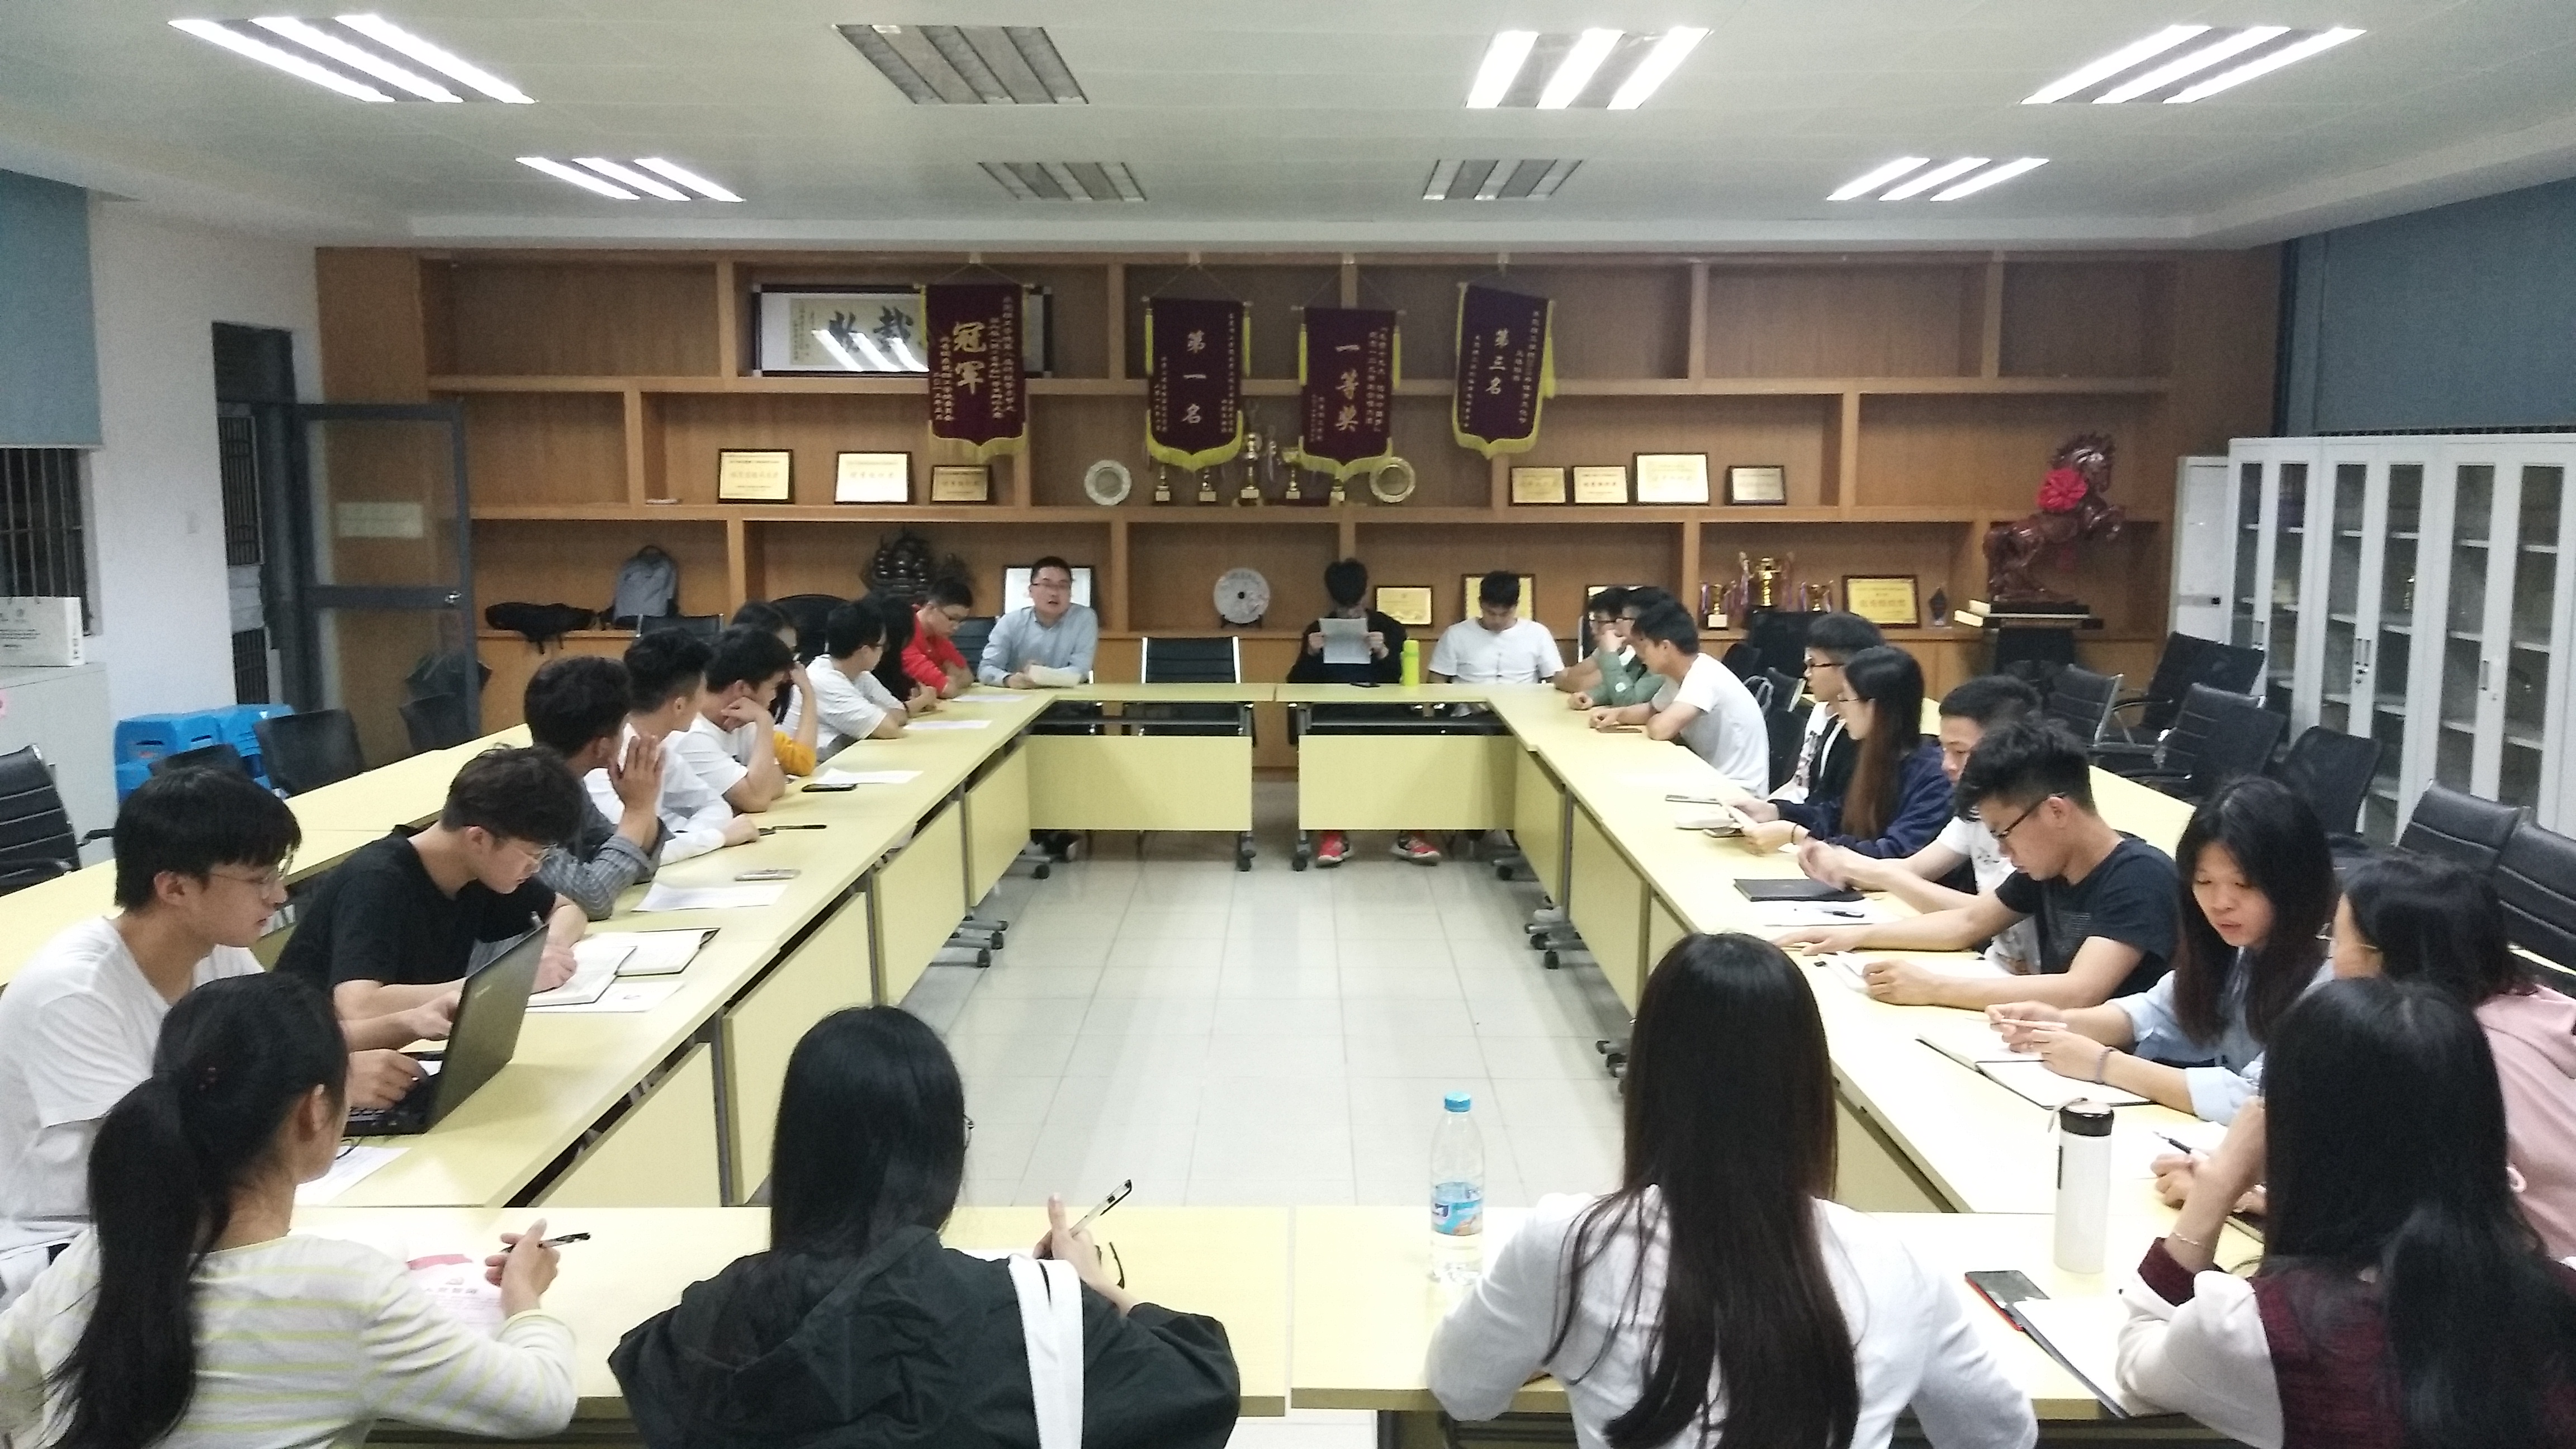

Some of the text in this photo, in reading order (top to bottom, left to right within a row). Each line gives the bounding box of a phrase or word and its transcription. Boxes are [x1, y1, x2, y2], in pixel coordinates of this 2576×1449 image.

[1182, 330, 1206, 424] 第一名
[1485, 329, 1509, 395] 第三名
